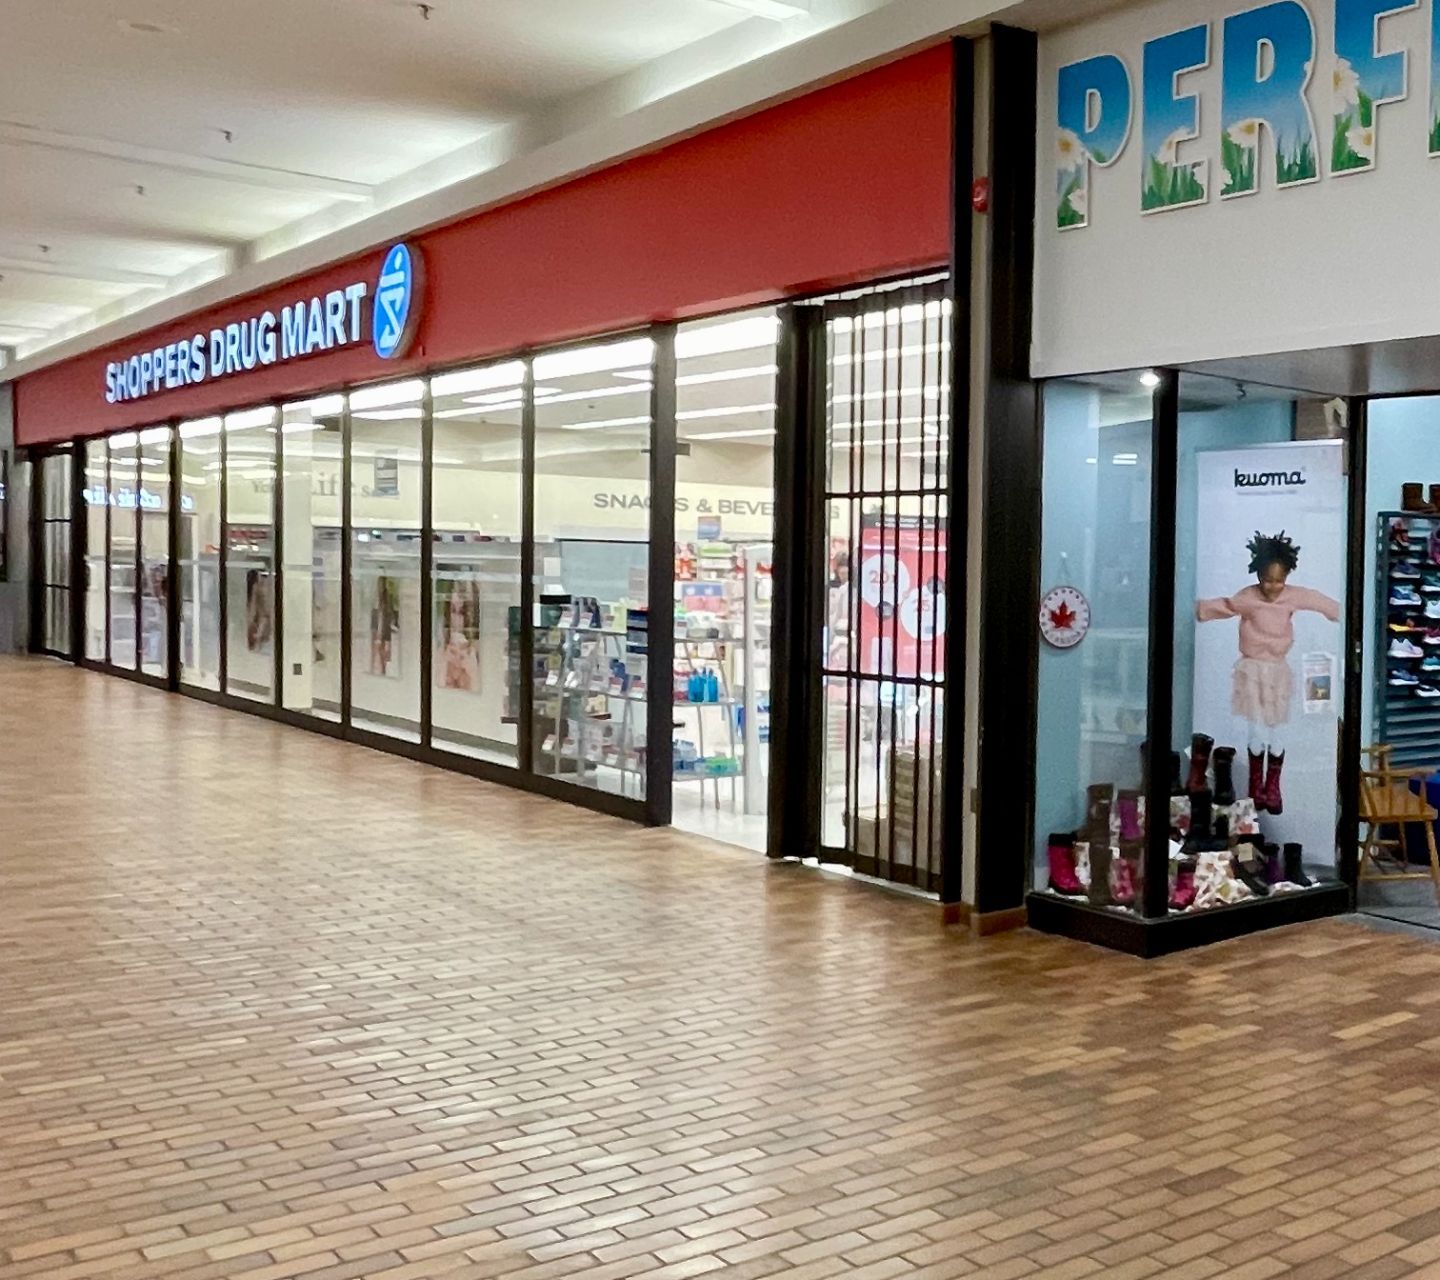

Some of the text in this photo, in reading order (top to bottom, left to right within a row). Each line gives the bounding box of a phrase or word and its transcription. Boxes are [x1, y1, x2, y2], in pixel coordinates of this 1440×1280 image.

[105, 282, 367, 404] SHOPPERS DRUG MART
[1234, 467, 1307, 488] kuoma
[593, 493, 690, 512] SNAS
